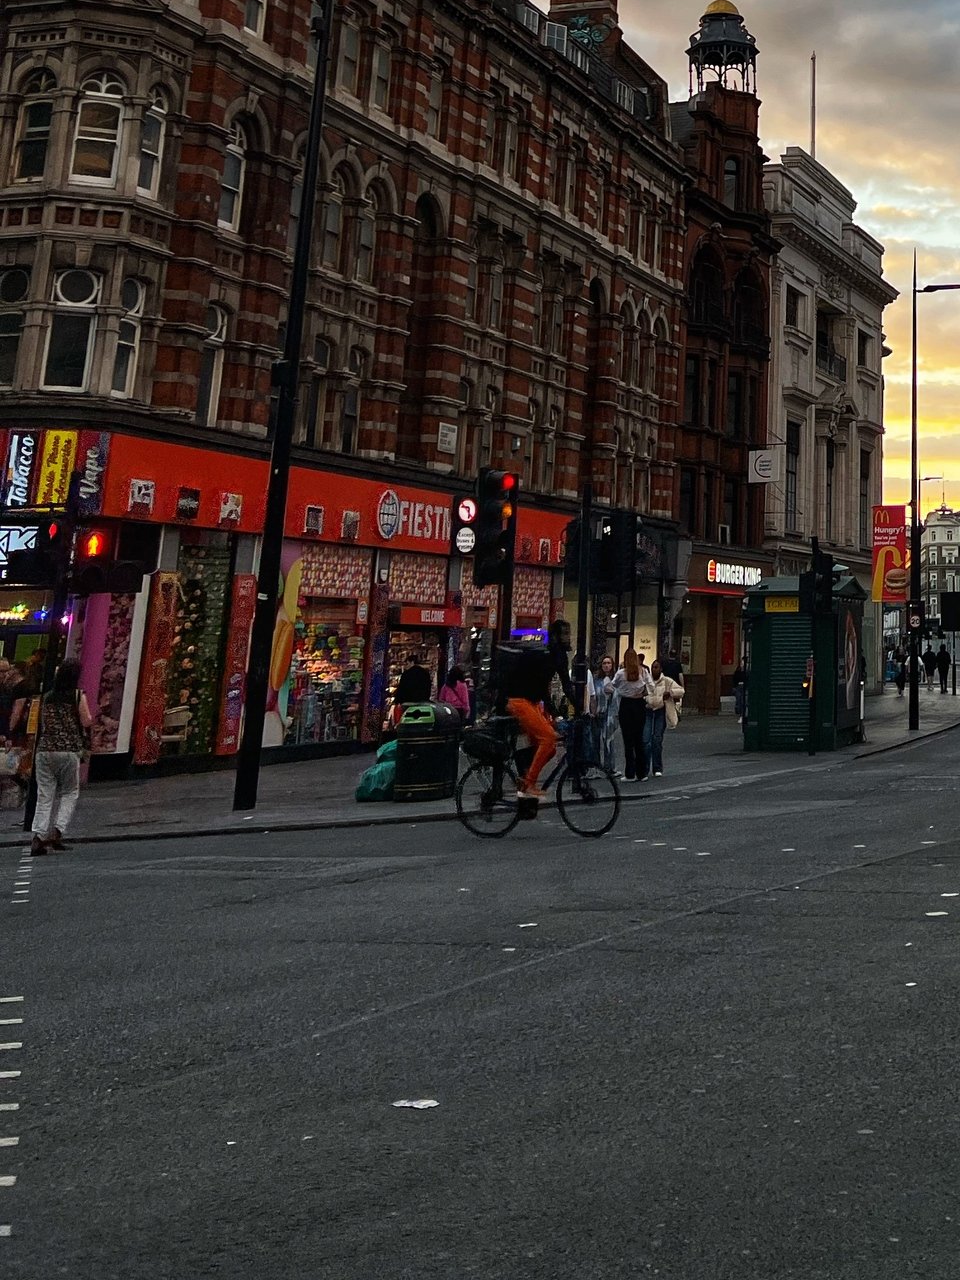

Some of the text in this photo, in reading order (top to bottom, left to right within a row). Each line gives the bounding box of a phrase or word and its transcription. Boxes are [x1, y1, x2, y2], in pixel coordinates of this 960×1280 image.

[874, 526, 904, 535] Hungry?
[715, 562, 762, 586] BURGER KING
[421, 610, 445, 623] WELCOME
[911, 617, 920, 625] 20
